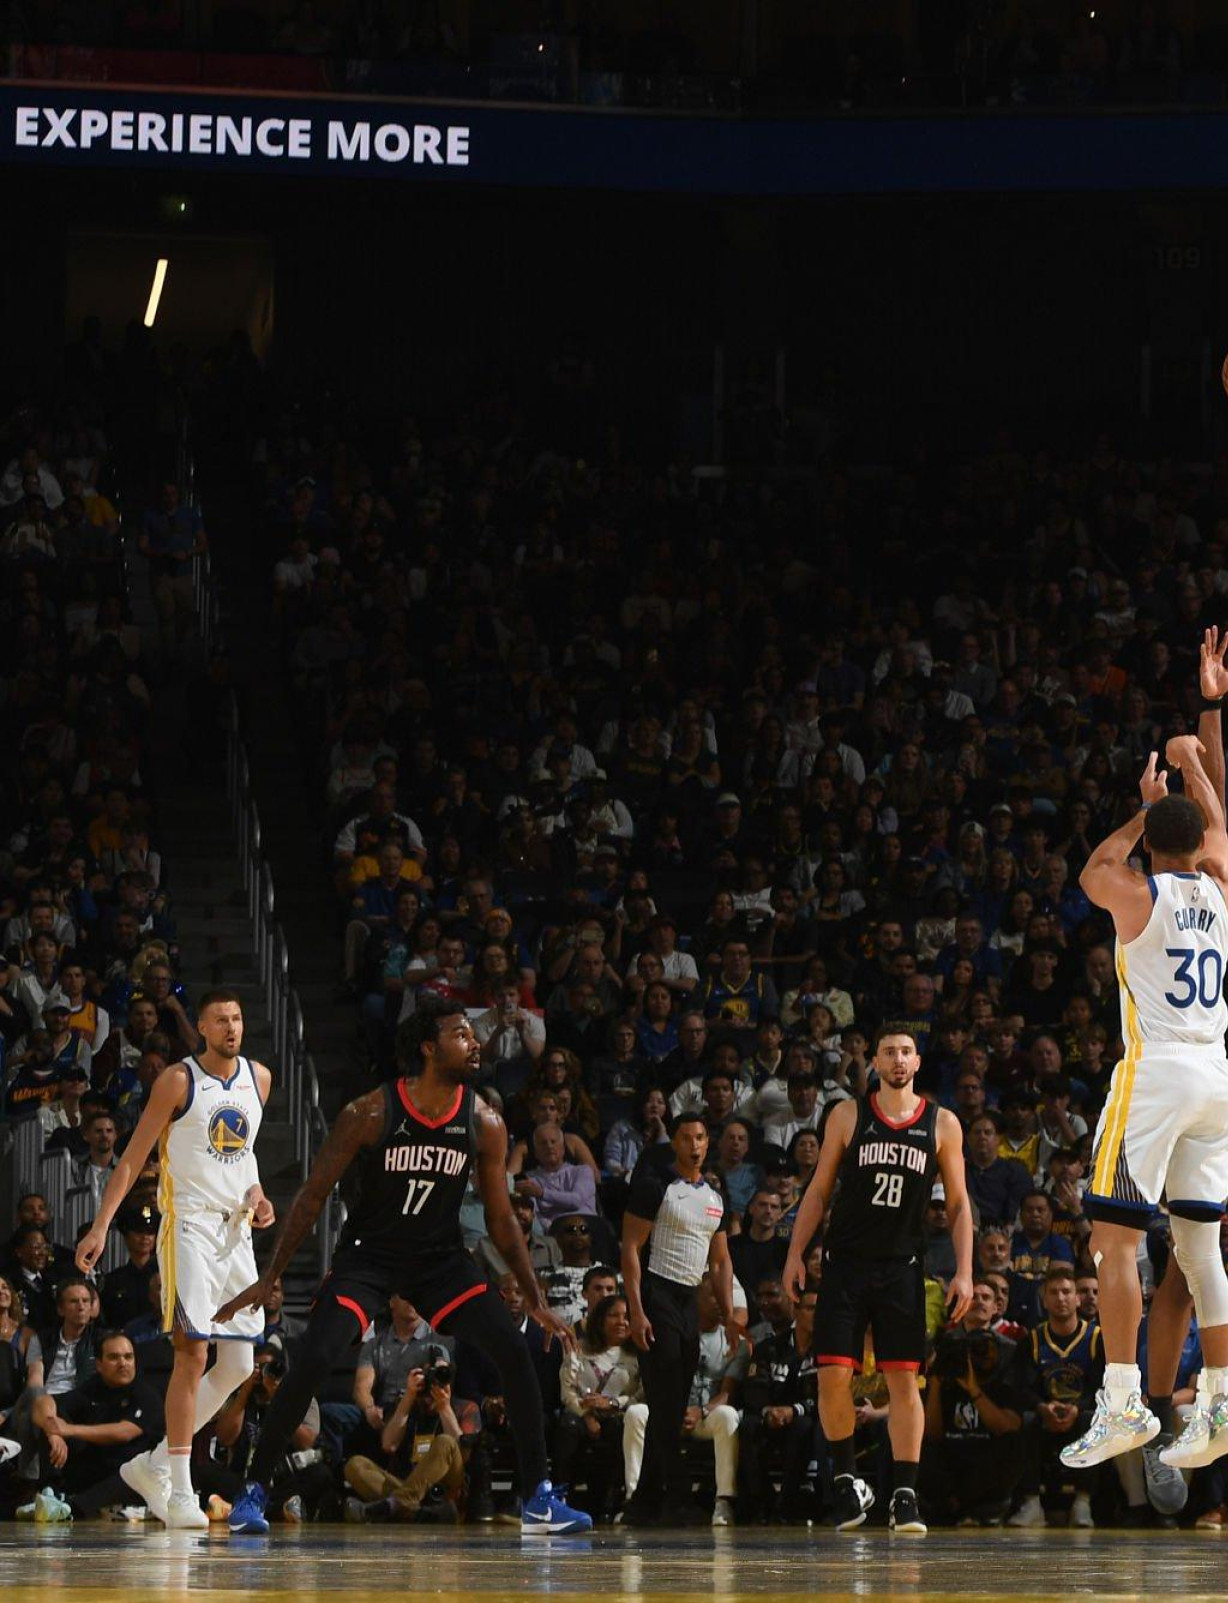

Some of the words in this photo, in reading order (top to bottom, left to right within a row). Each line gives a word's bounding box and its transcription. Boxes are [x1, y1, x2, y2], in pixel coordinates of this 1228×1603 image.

[15, 107, 312, 158] EXPERIENCE
[327, 121, 470, 165] MORE
[1174, 906, 1216, 933] CURRY
[1164, 948, 1222, 1009] 30
[235, 1118, 243, 1133] 7
[206, 1145, 250, 1165] WARRIORS
[384, 1144, 467, 1176] HOUSTON
[858, 1141, 927, 1175] HOUSTON
[402, 1179, 435, 1214] 17
[871, 1172, 904, 1208] 28
